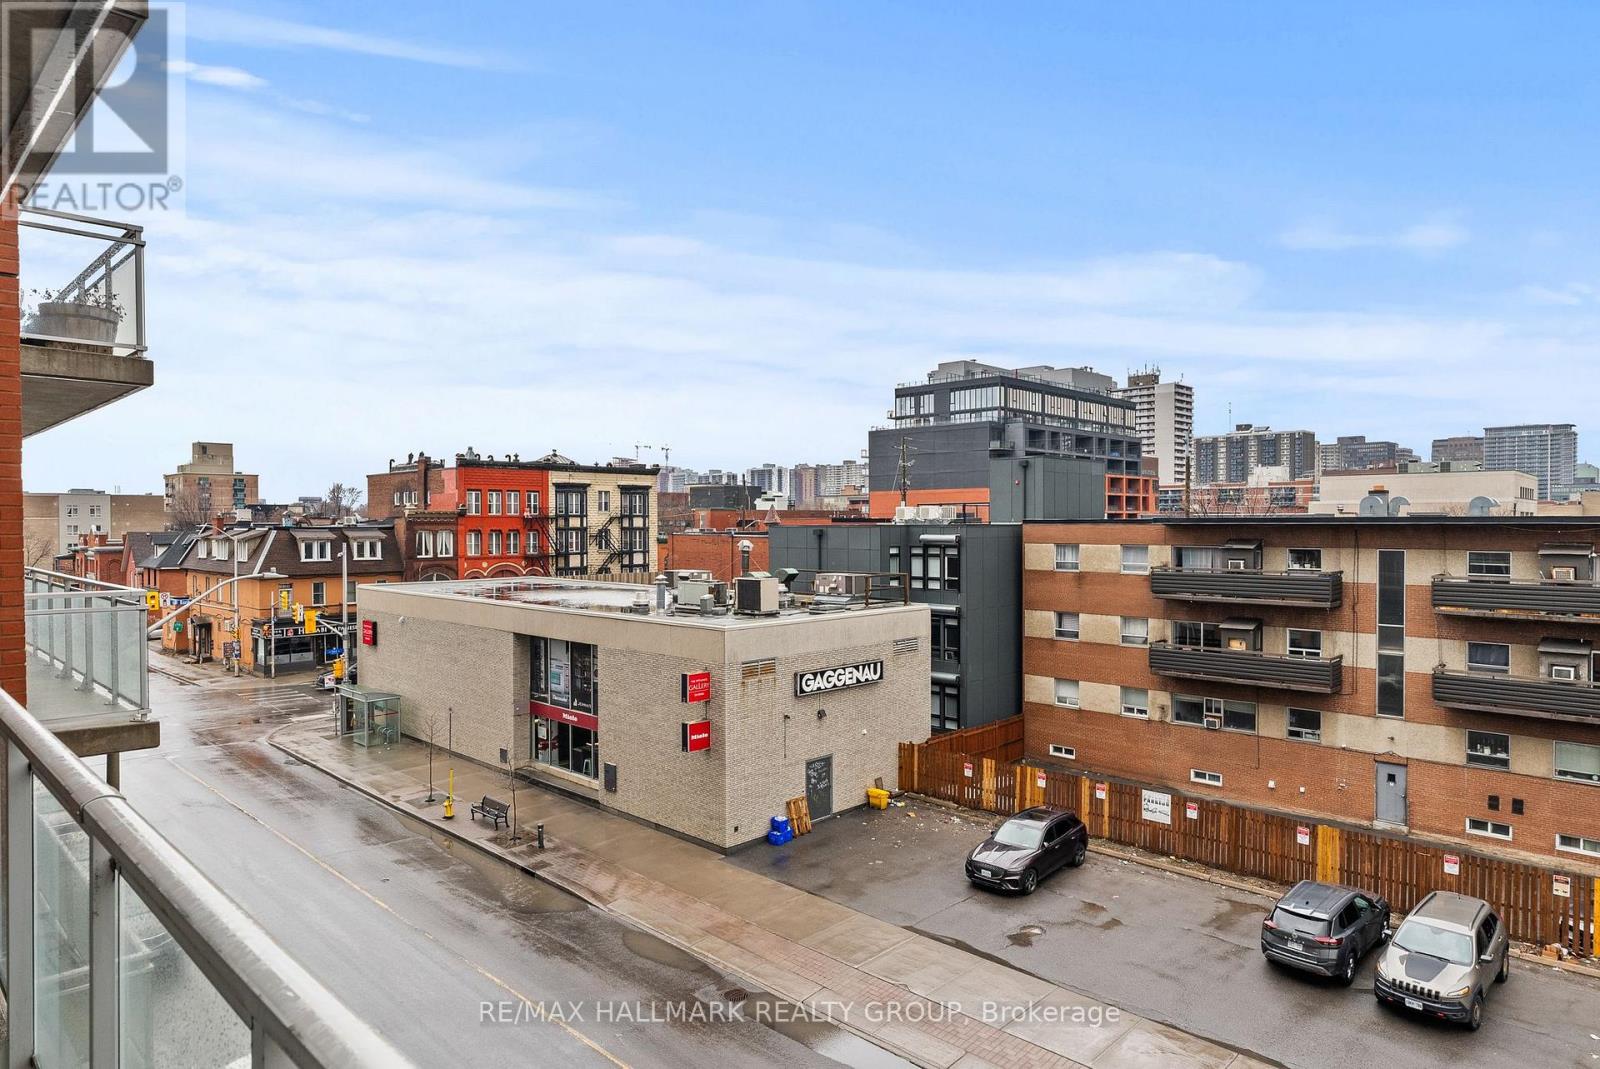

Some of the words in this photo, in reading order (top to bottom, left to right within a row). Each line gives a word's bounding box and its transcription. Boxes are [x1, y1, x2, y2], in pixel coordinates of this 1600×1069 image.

[801, 662, 881, 692] GAGGENAU
[562, 712, 578, 722] Miele
[690, 732, 709, 740] Miele
